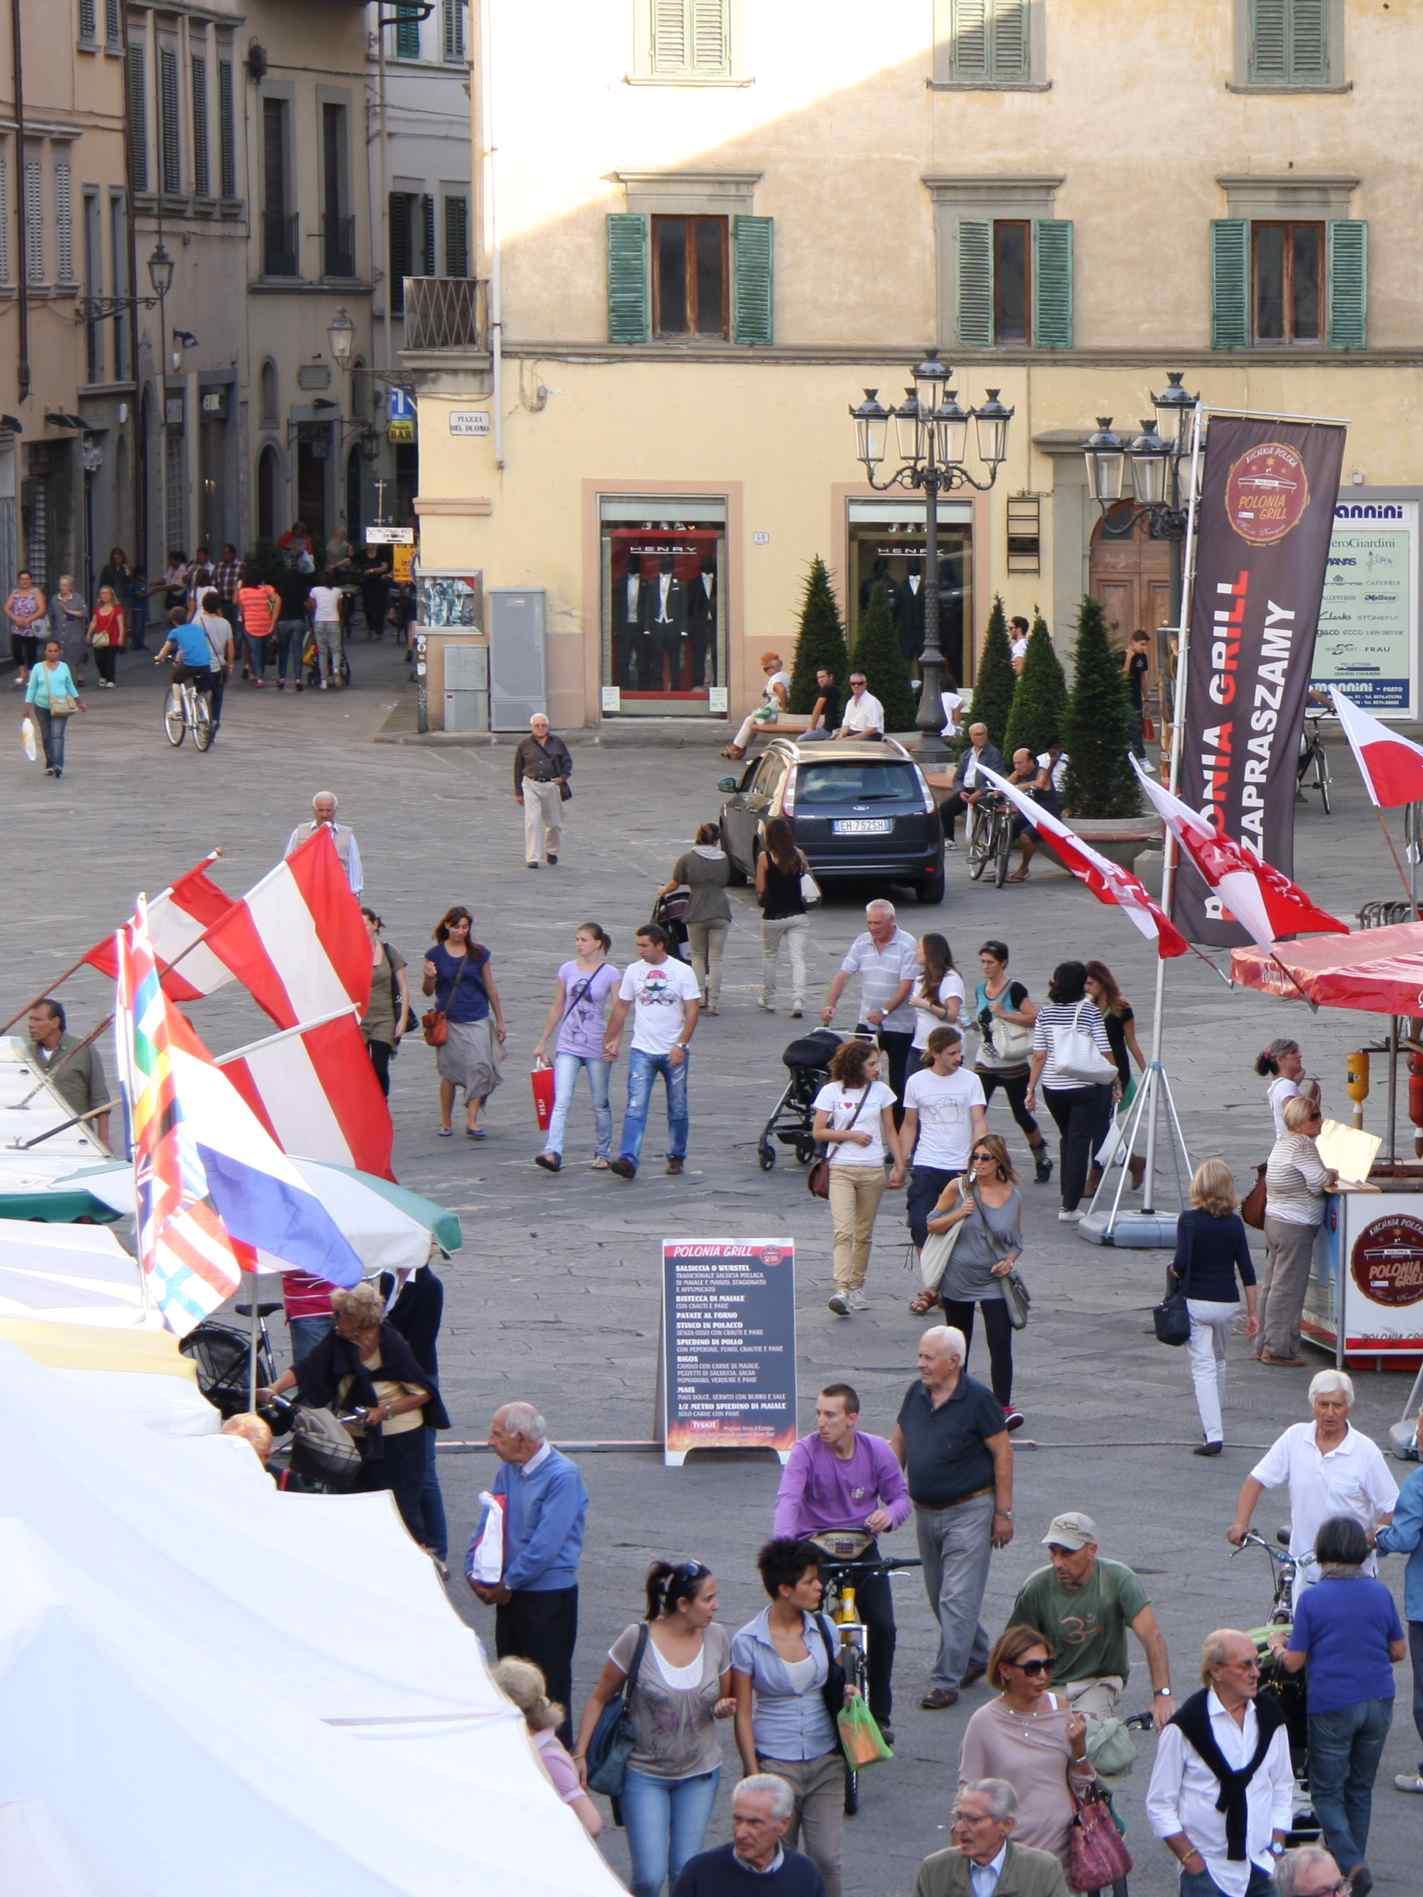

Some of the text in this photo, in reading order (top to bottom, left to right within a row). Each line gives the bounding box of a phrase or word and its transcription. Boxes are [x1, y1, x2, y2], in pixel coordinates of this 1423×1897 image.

[1238, 495, 1287, 509] POLONIA
[1258, 508, 1288, 521] GRILL
[1334, 504, 1403, 520] annini
[1330, 538, 1396, 549] eroGiardini
[1241, 600, 1296, 866] ZAPRASZAMY
[1201, 570, 1248, 922] PONIA GRILL
[673, 1246, 753, 1257] POLONIA GRILL
[1368, 1261, 1420, 1280] POLONIA
